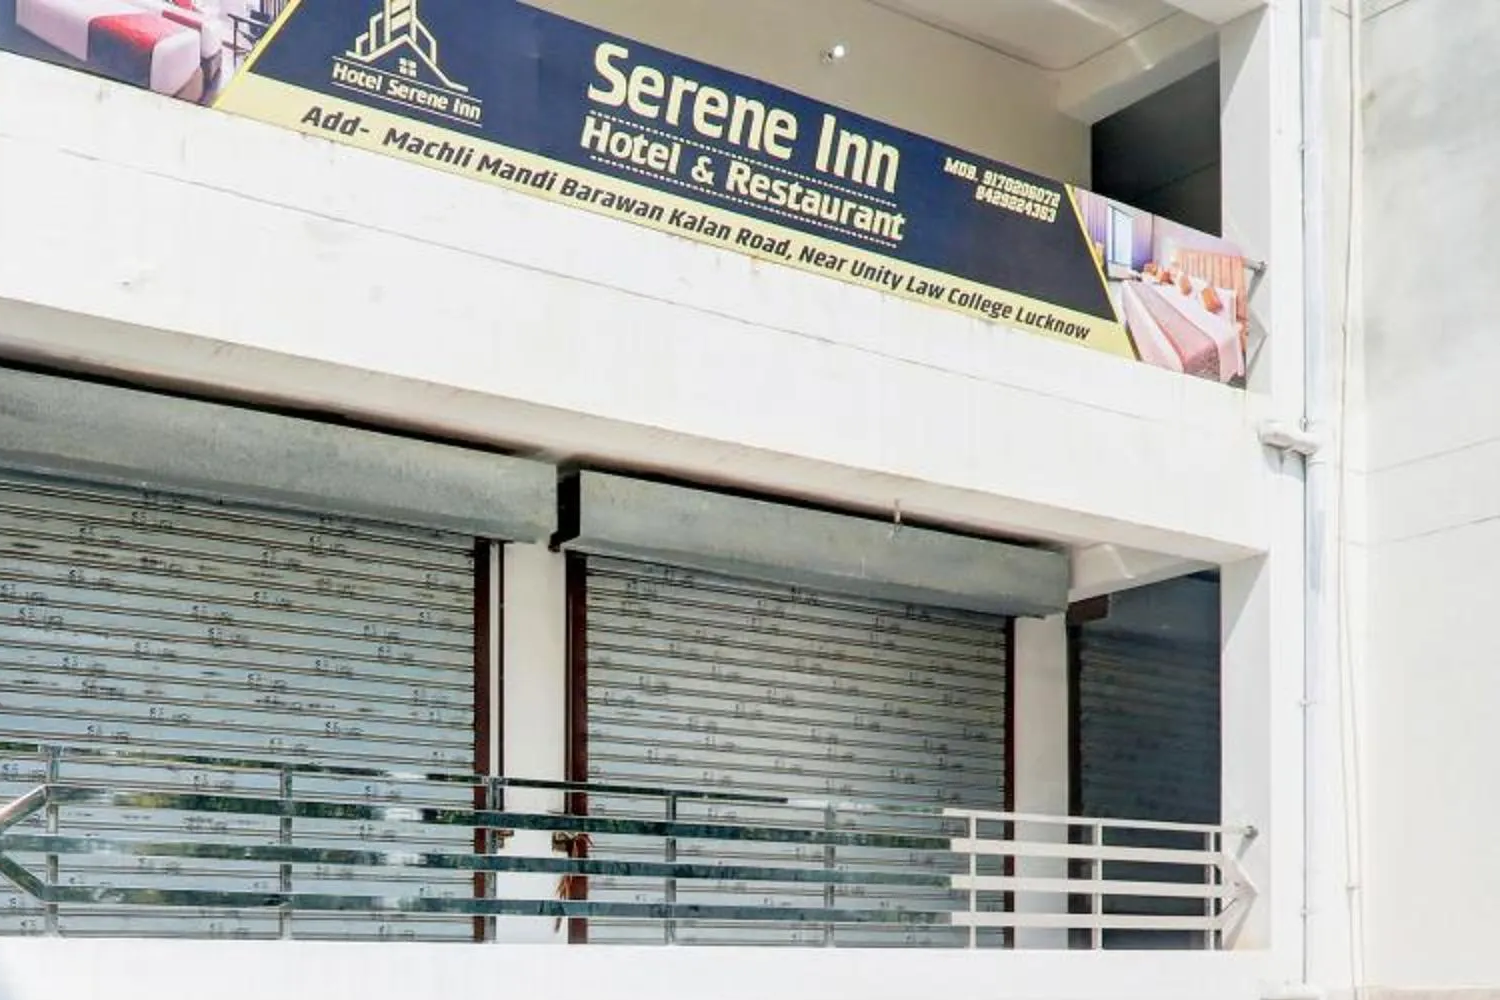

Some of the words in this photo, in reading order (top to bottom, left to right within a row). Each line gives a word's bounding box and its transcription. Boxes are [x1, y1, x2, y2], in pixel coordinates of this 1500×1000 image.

[332, 62, 382, 91] Hotel
[387, 79, 448, 111] Serene
[453, 99, 482, 121] Inn
[587, 41, 798, 160] Serene
[815, 113, 900, 193] Inn
[301, 106, 370, 136] Add-
[382, 127, 475, 167] Machli
[476, 154, 559, 191] Mandi
[560, 177, 666, 222] Barawan
[668, 208, 732, 241] Kalan
[735, 227, 793, 261] Road,
[800, 246, 848, 273] Near
[851, 259, 904, 292] Unity
[906, 275, 945, 300] Law
[947, 287, 1013, 319] College
[1015, 306, 1090, 340] Lucknow
[580, 115, 681, 175] Hotel
[691, 155, 715, 186] &
[725, 160, 906, 241] Restaurant
